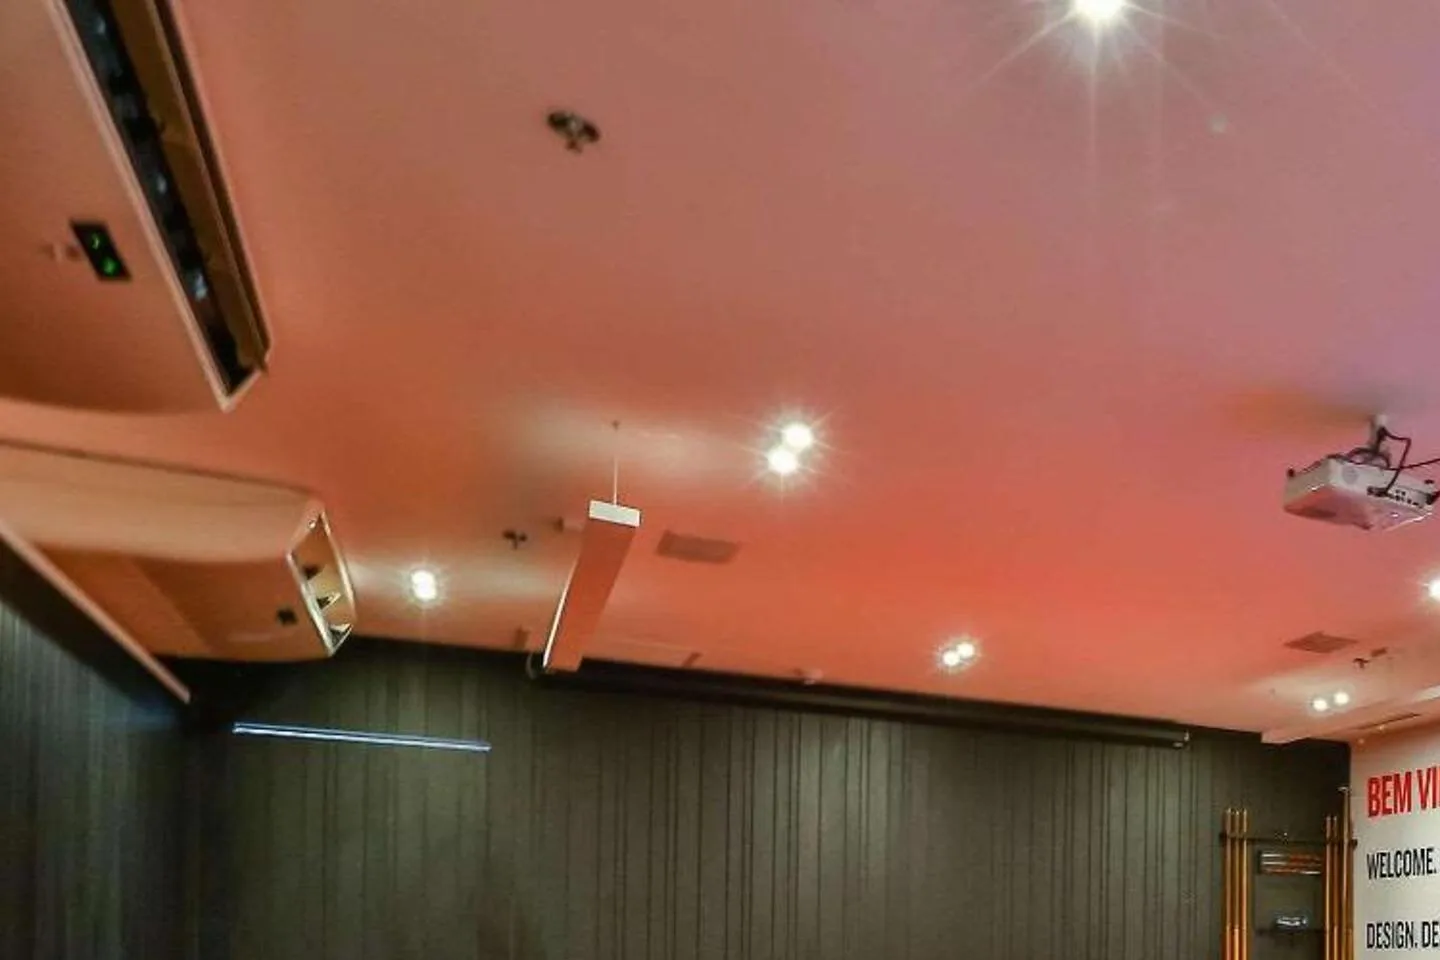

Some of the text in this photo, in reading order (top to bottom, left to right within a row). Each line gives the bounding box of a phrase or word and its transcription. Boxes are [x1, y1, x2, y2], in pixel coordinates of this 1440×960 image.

[1367, 771, 1412, 817] BEM
[1367, 846, 1437, 880] WELCOME.
[1366, 920, 1417, 949] DESIGN.
